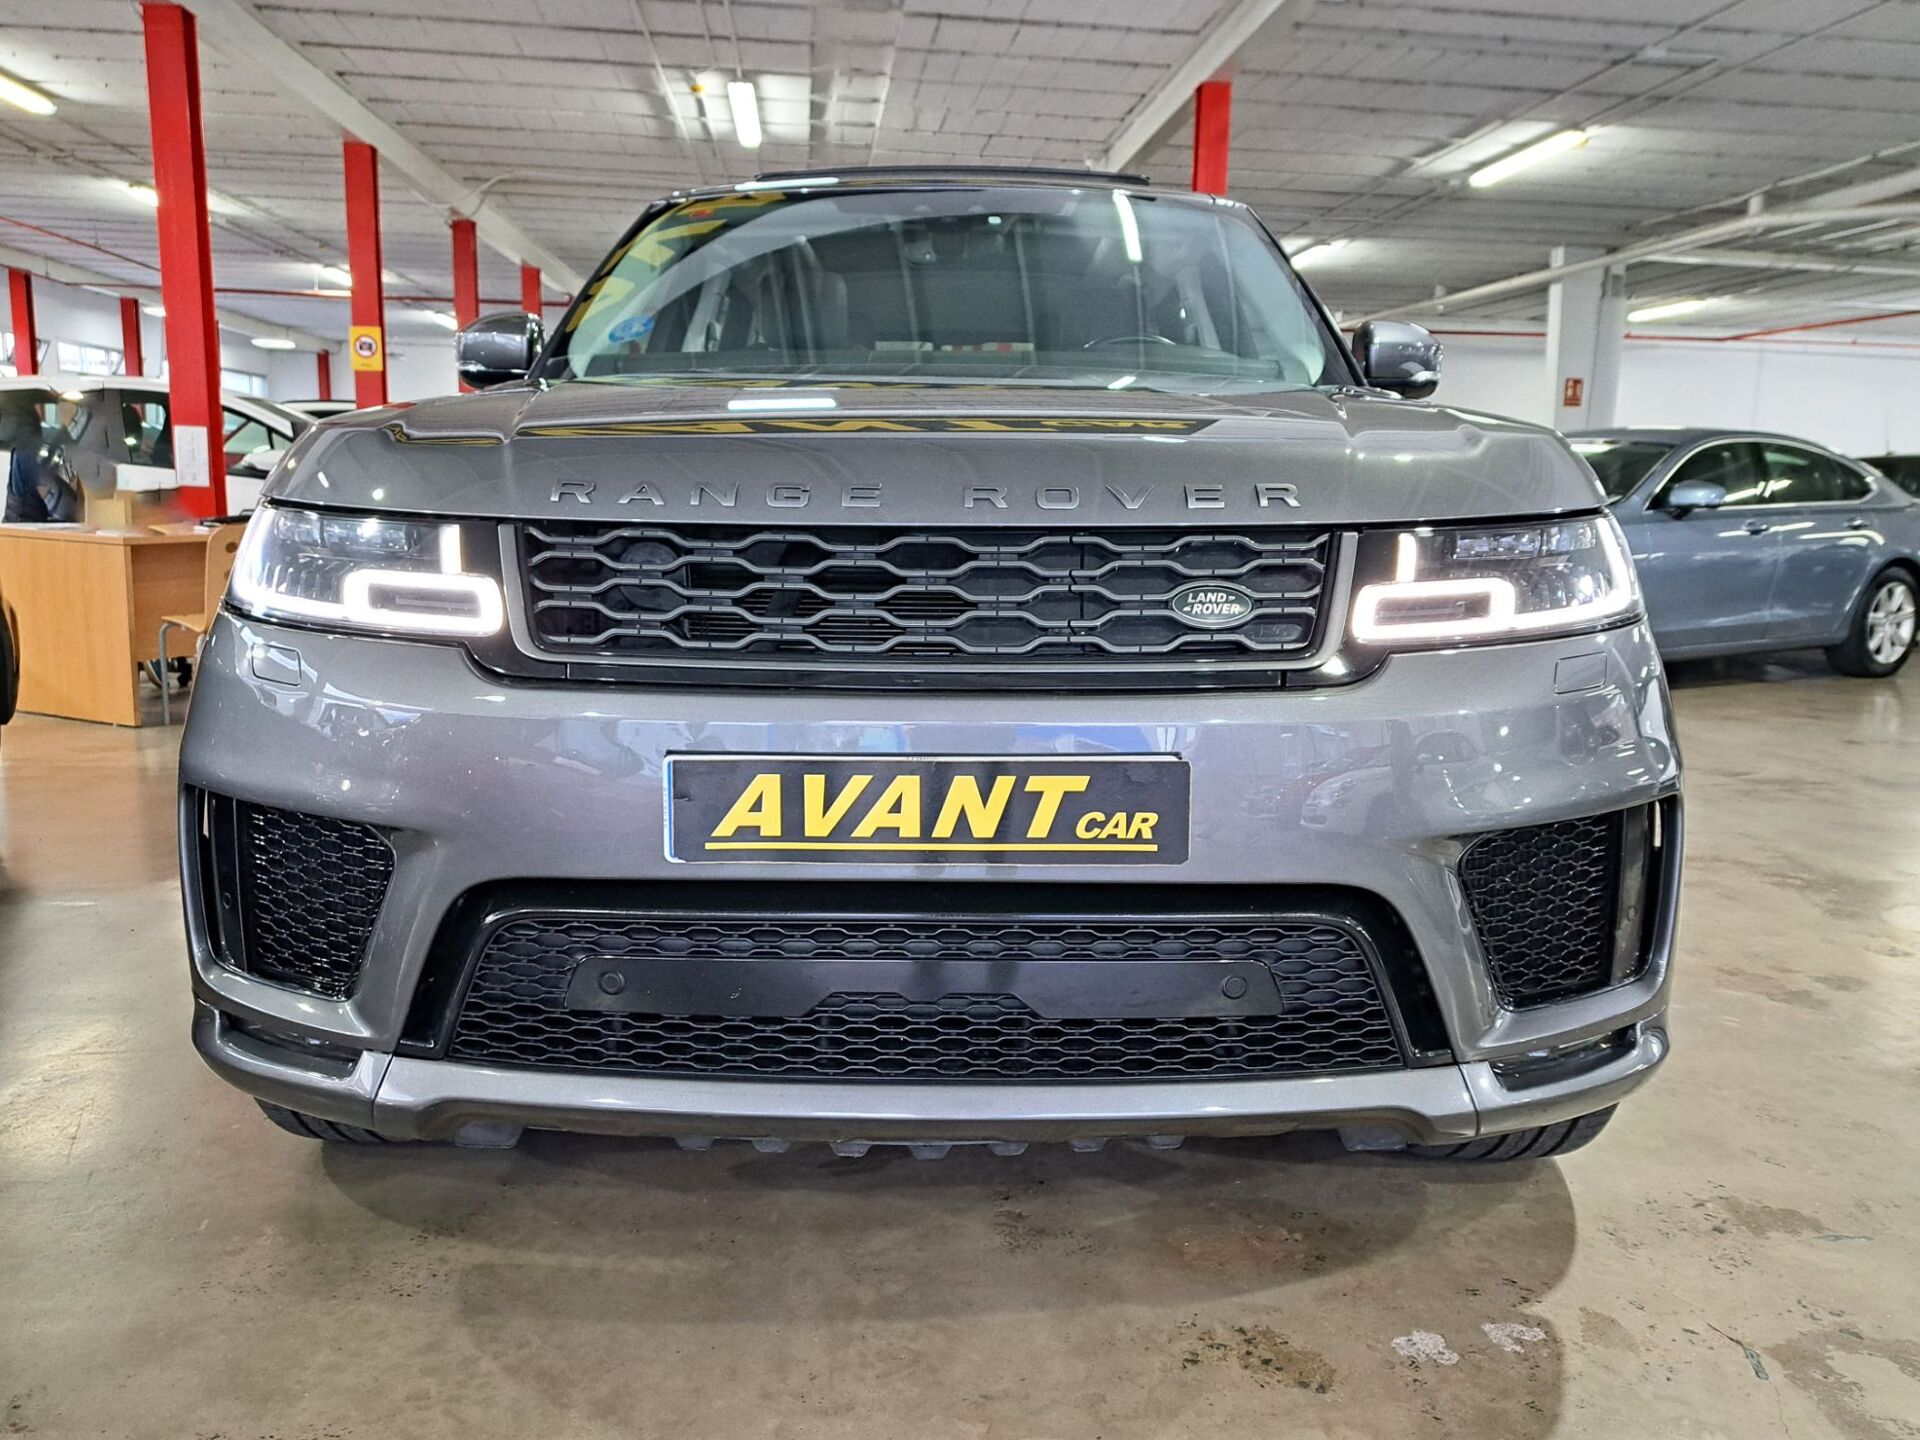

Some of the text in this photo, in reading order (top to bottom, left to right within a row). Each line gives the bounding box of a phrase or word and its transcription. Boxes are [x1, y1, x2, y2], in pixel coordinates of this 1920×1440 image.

[550, 481, 1302, 510] RANGE ROVER
[1187, 592, 1227, 603] LAND
[1191, 603, 1240, 615] ROVER
[710, 773, 1091, 839] AVANT
[1075, 811, 1158, 840] CAR
